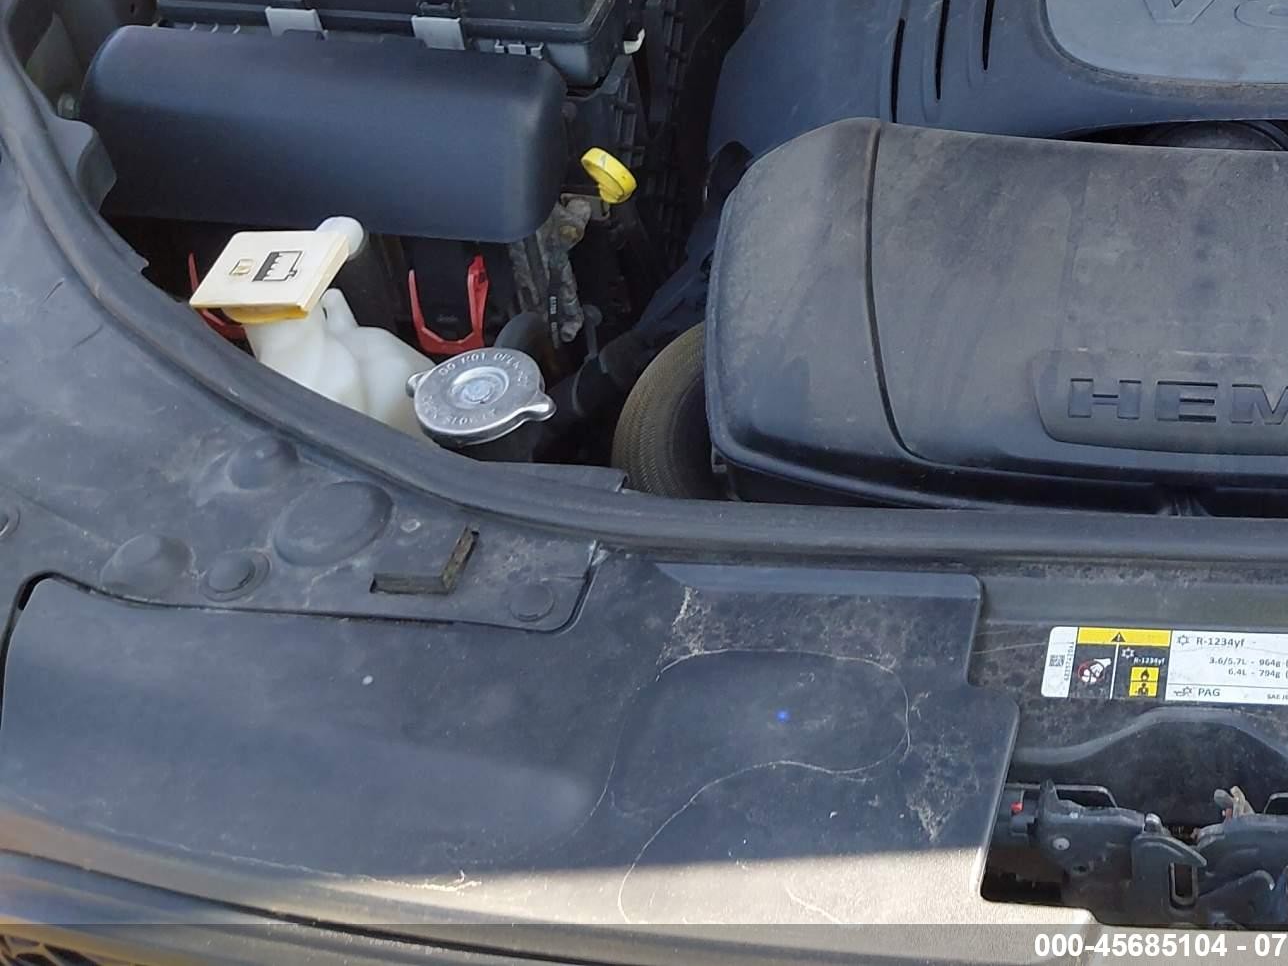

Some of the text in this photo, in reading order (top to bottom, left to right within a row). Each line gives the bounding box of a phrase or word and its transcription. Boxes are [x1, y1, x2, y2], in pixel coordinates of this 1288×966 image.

[437, 361, 456, 377] DO
[460, 351, 488, 365] NOT
[1196, 636, 1245, 649] R-1234yf
[1209, 656, 1247, 666] 3.6/5.7L
[1228, 668, 1247, 677] 6.4L
[1198, 688, 1221, 697] PAG
